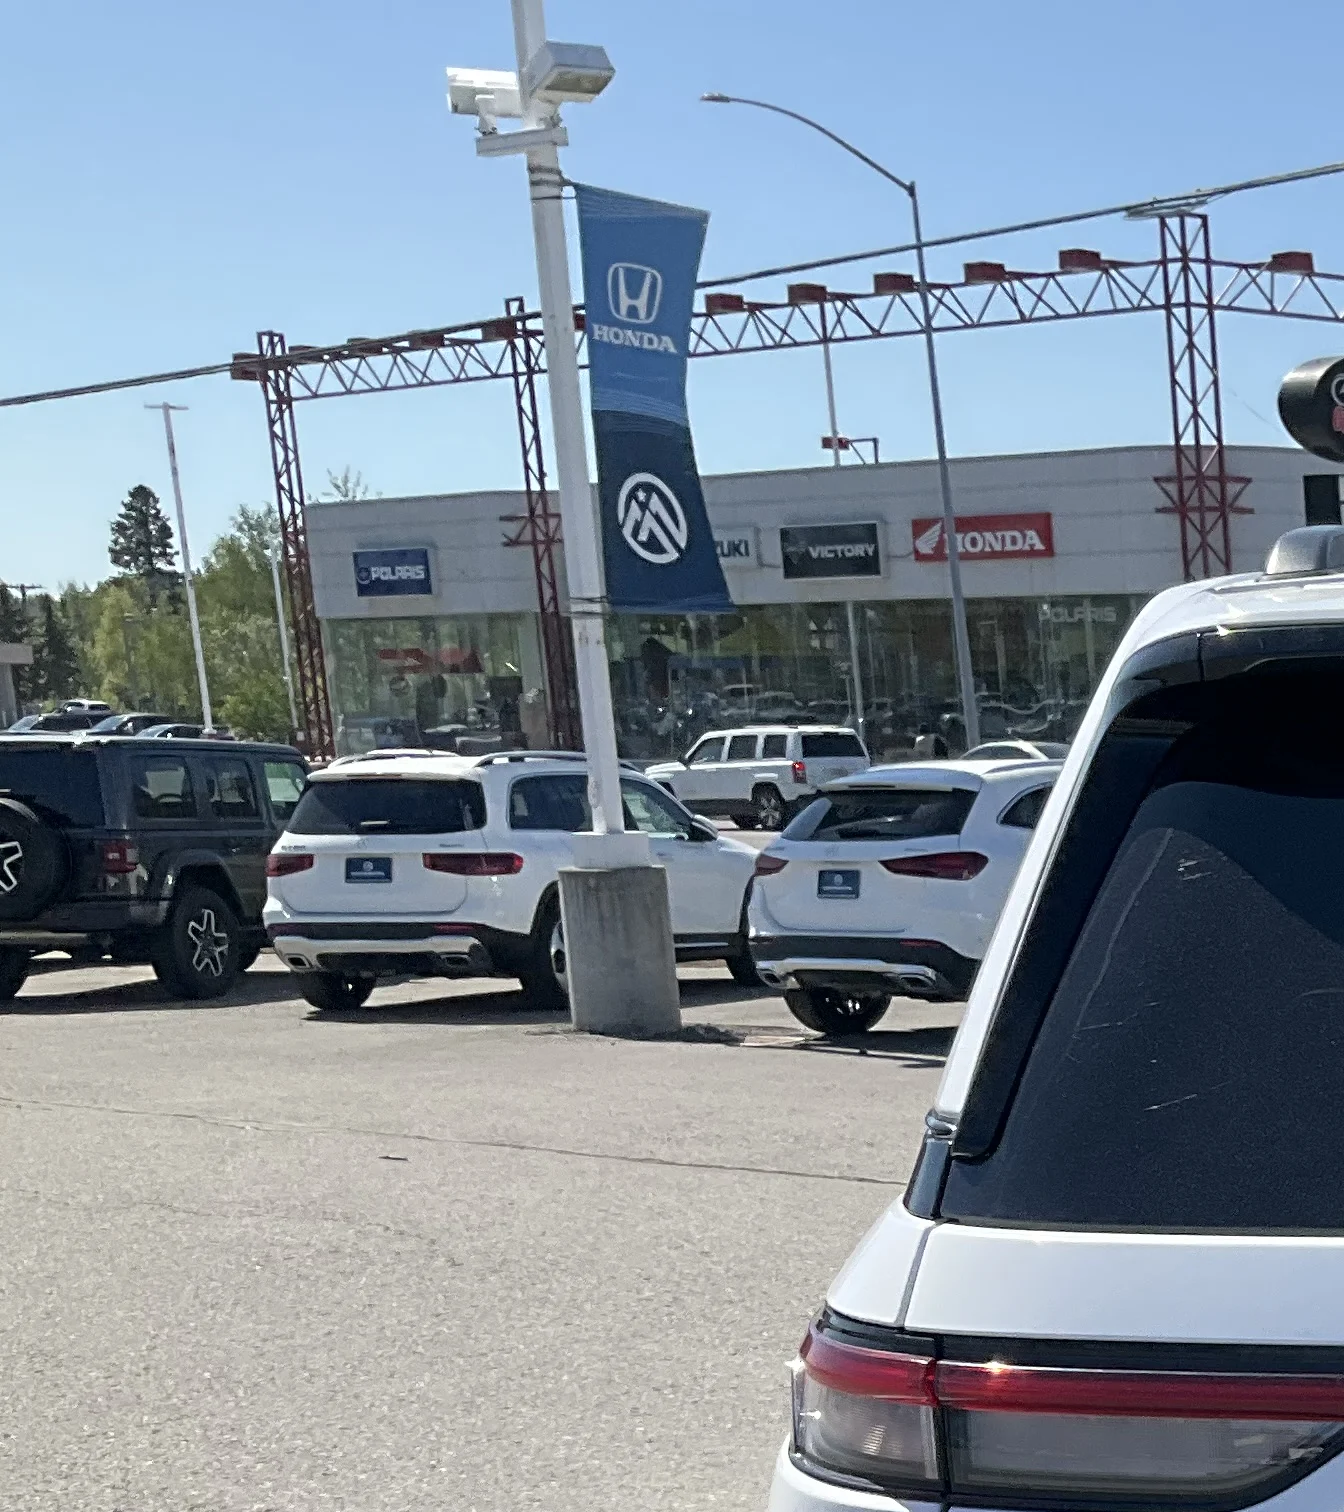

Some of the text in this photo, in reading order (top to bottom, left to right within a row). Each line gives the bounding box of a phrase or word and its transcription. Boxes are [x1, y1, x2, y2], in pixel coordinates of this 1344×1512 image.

[592, 323, 678, 354] HONDA
[943, 529, 1046, 553] HONDA
[808, 543, 876, 560] VICTORY
[371, 565, 425, 580] POLARIS
